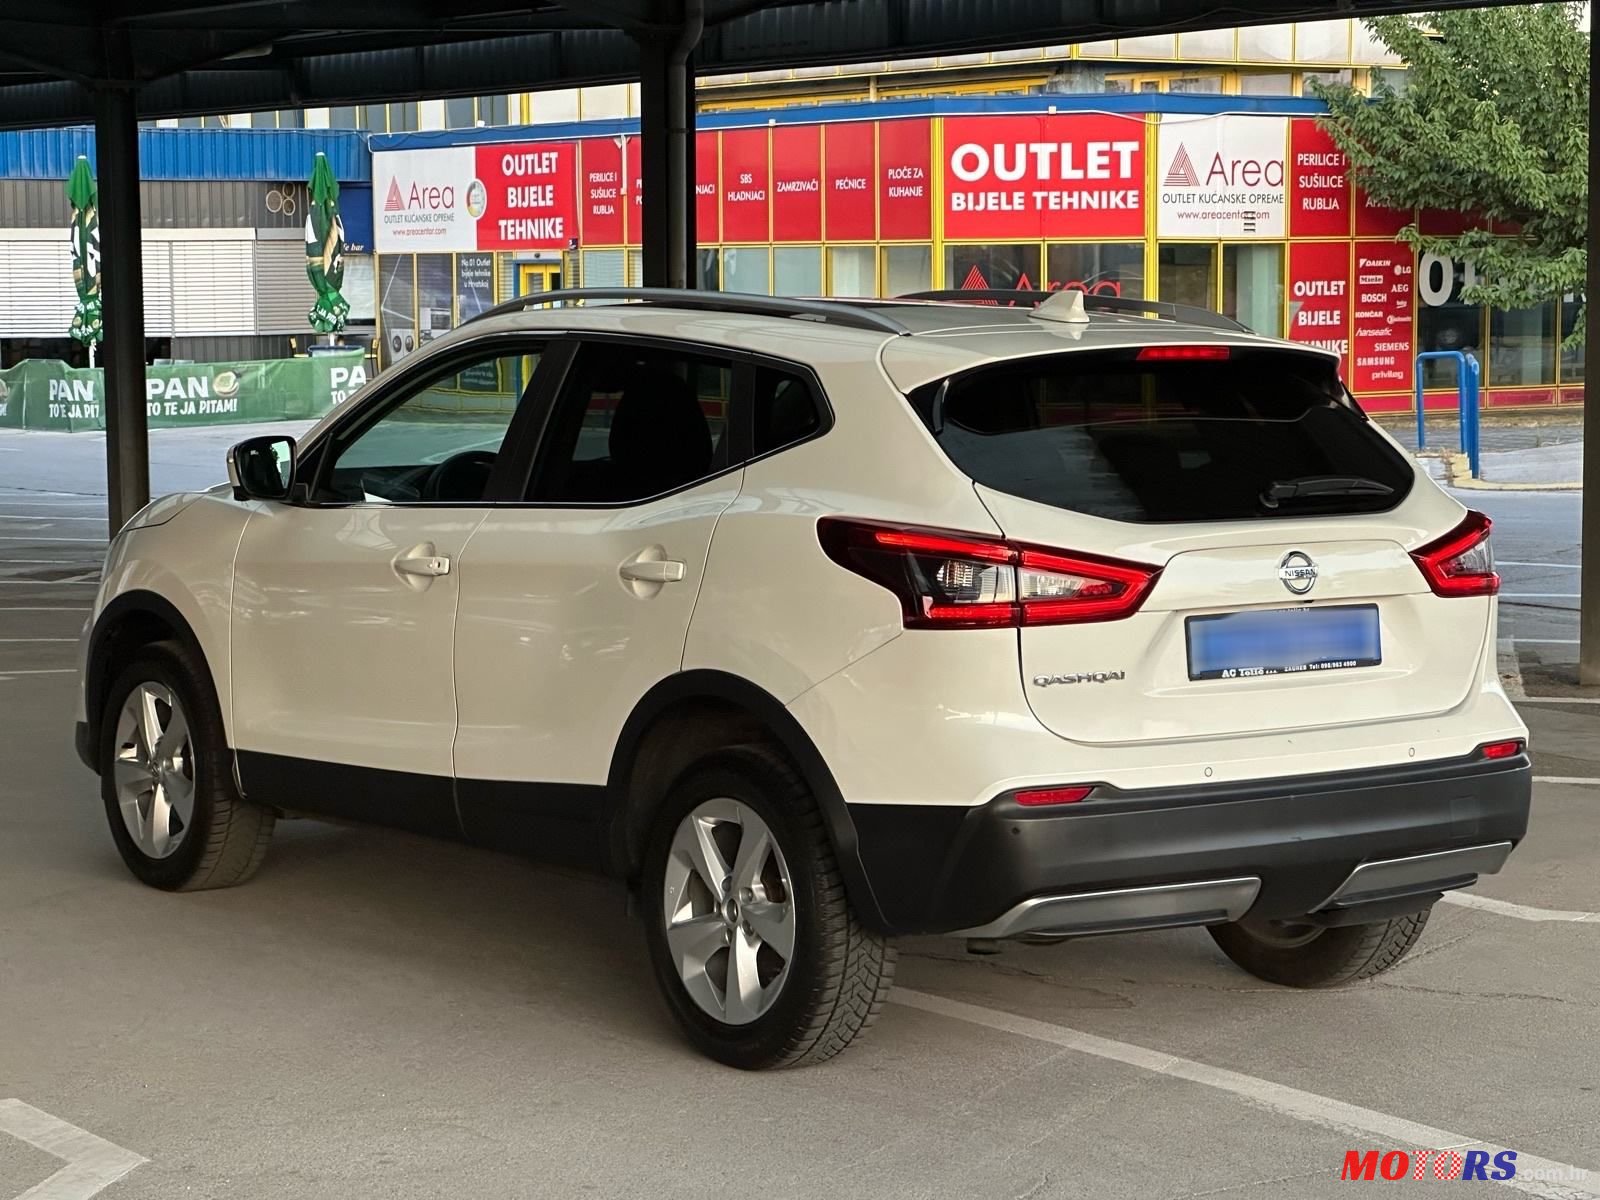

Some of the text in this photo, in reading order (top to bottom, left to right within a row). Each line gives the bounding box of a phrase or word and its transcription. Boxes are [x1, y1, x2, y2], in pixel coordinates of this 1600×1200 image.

[502, 152, 558, 176] OUTLET
[950, 141, 1140, 182] OUTLET
[1297, 153, 1340, 166] PERILICE
[888, 166, 924, 179] PLOČE ZA
[1205, 151, 1284, 187] Area
[589, 172, 614, 182] PERILICE
[740, 174, 753, 184] SBS
[1298, 173, 1344, 188] SUŠILICE
[777, 179, 819, 192] ZAMRZIVAČI
[888, 186, 923, 198] KUHANJE
[408, 180, 455, 210] Area
[507, 185, 554, 208] BIJELE
[591, 187, 617, 199] SUŠILICE
[727, 191, 765, 201] HLADNJACI
[1162, 193, 1197, 204] OUTLET
[1249, 193, 1285, 204] OPREME
[951, 190, 1140, 211] BIJELE TEHNIKE
[1302, 197, 1340, 210] RUBLJA
[593, 205, 615, 215] RUBLJA
[384, 214, 405, 225] OUTLET
[433, 212, 455, 222] OPREME
[498, 217, 564, 241] TEHNIKE
[1293, 281, 1346, 297] OUTLET
[1391, 284, 1409, 293] AEG
[1361, 293, 1387, 304] BOSCH
[1298, 311, 1341, 326] BIJELE
[1355, 310, 1383, 319] KONČAR
[1355, 327, 1393, 337] hanseatic
[1374, 342, 1410, 352] SIEMENS
[1357, 356, 1395, 366] SAMSUNG
[49, 379, 94, 402] PAN
[146, 376, 209, 401] PAN
[49, 403, 60, 418] TO
[68, 404, 83, 419] JA
[147, 398, 238, 417] TO TE JA PITAM!
[1284, 568, 1316, 578] NISSAN
[1033, 670, 1126, 687] QASHQAI
[1221, 668, 1237, 678] AC
